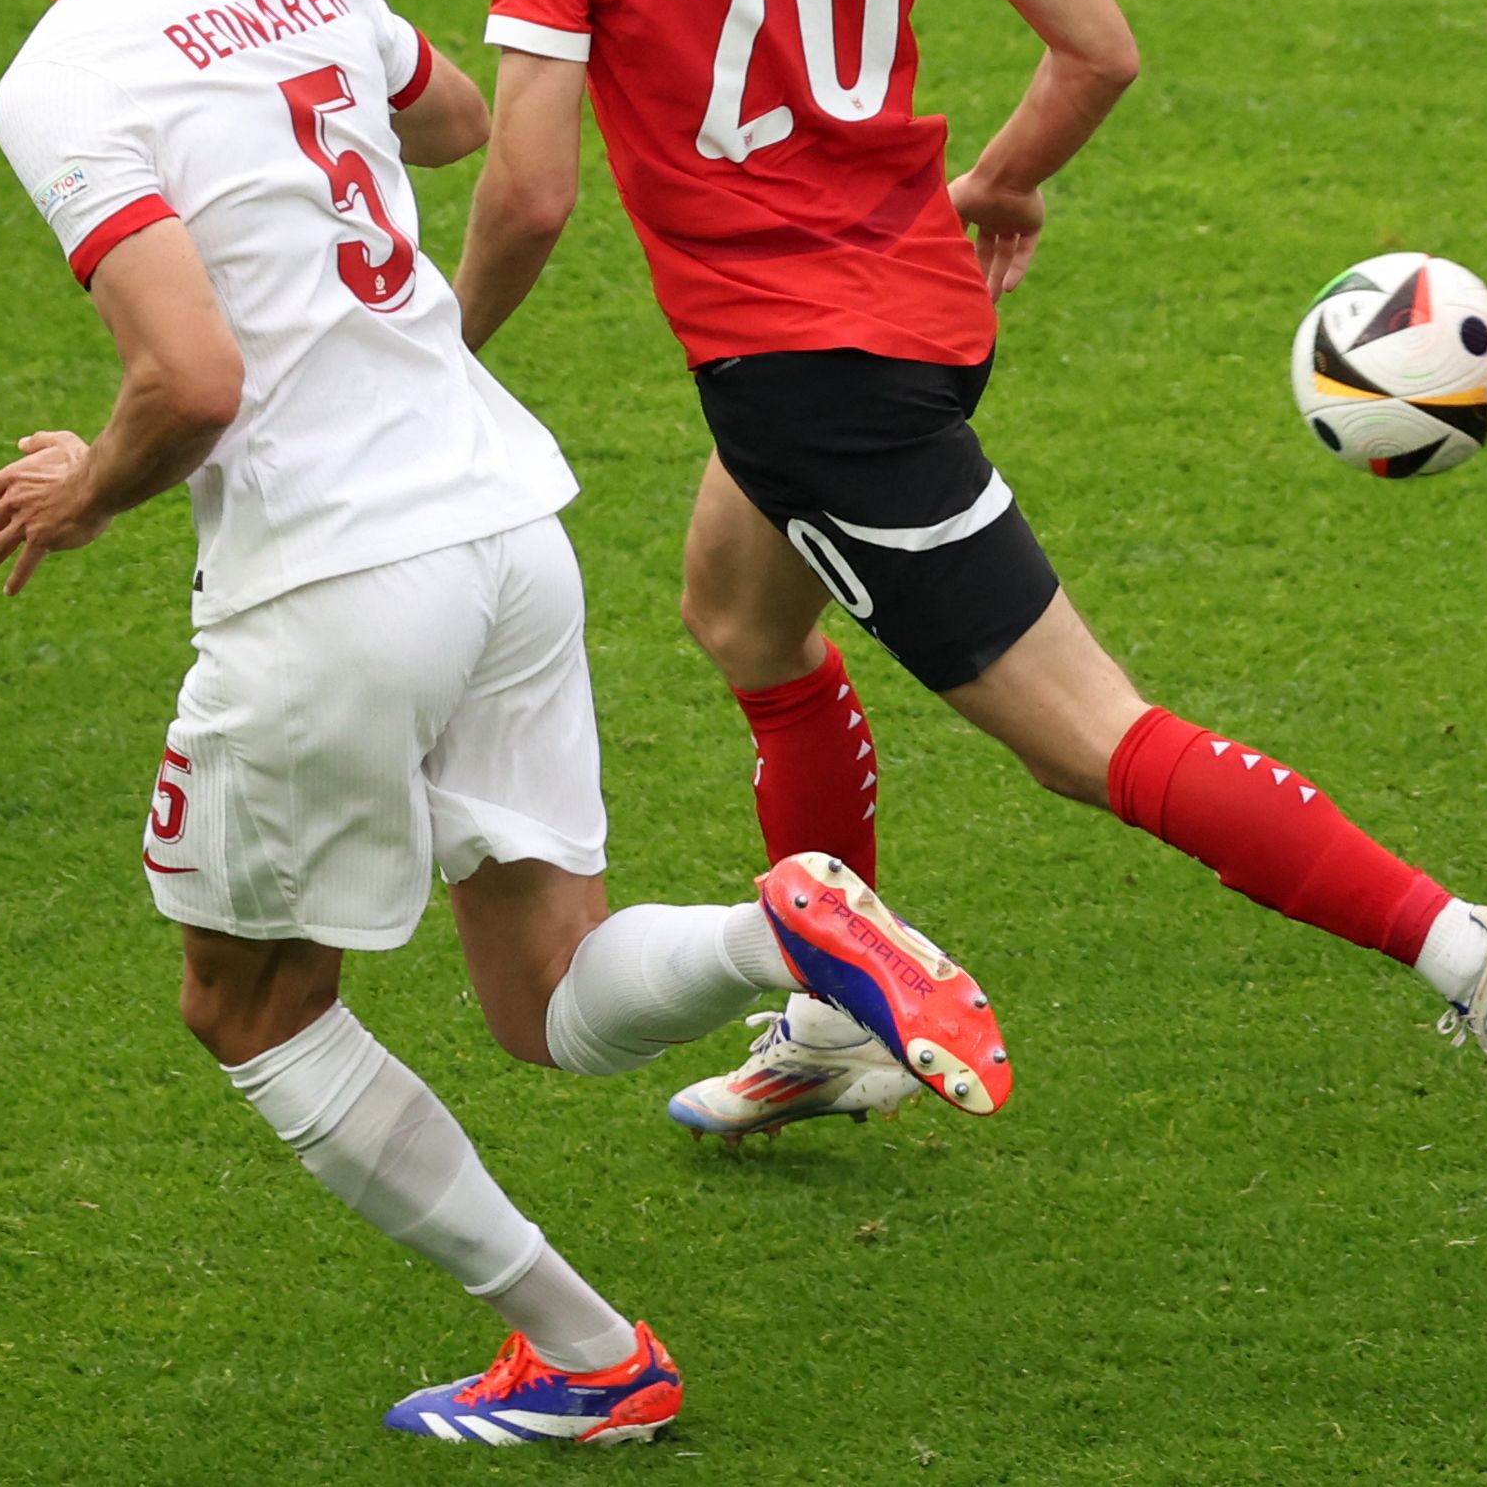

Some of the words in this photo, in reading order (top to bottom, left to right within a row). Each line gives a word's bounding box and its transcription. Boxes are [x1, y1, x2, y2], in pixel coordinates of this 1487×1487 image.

[277, 63, 416, 314] 5
[150, 744, 192, 845] 5
[818, 891, 936, 1001] PREDATOR
